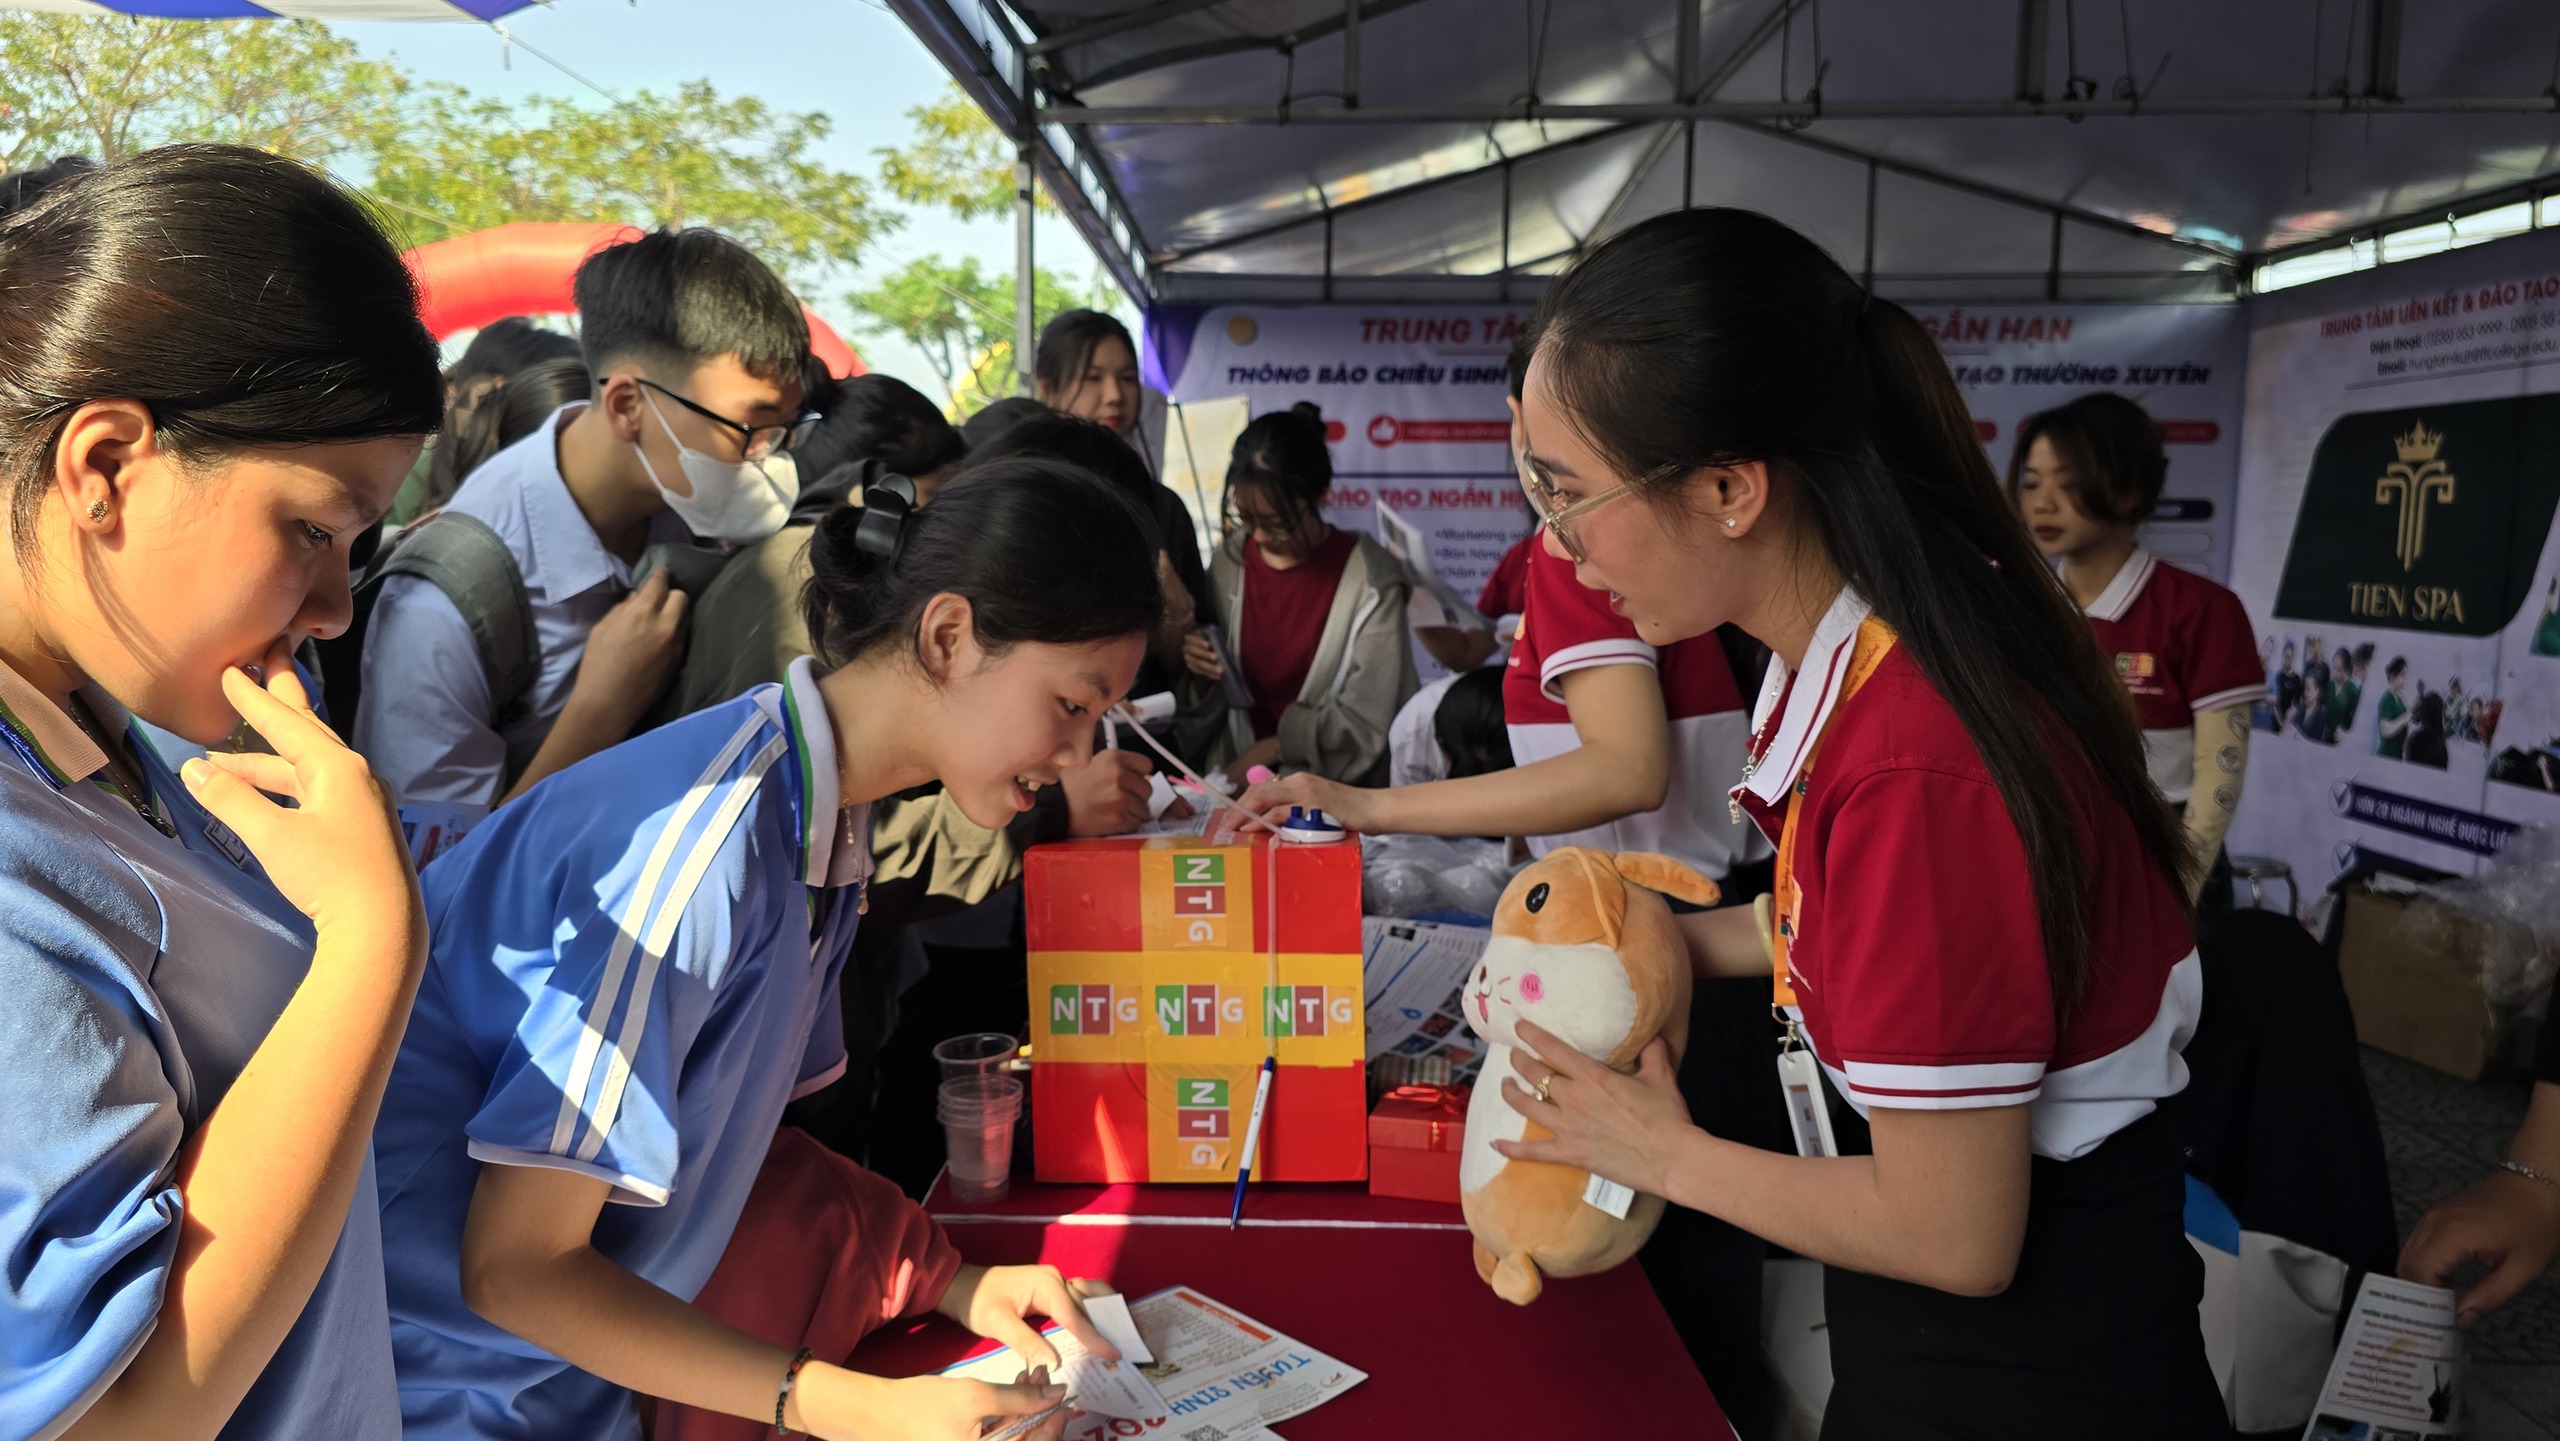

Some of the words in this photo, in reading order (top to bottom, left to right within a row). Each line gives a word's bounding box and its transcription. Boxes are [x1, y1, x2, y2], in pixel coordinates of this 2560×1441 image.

[1361, 317, 1472, 344] TRUNG
[1481, 311, 1518, 344] TÂ
[1921, 308, 1990, 343] GẮN
[1996, 315, 2075, 349] HẠN
[2320, 312, 2362, 338] TRUNG
[2365, 304, 2395, 331] TÂM
[1228, 360, 1311, 385] THÔNG
[1317, 360, 1369, 385] BÁO
[1375, 360, 1445, 385] CHIÊU
[1450, 364, 1509, 385] SINH
[1955, 365, 2004, 391] TẠO
[2010, 361, 2119, 386] THƯỜNG
[2122, 362, 2209, 386] XUYÊN
[1428, 479, 1493, 508] NGẮN
[2347, 581, 2406, 618] TIEN
[2412, 585, 2465, 624] SPA
[1187, 858, 1214, 942] NTG
[1053, 997, 1139, 1023] NTG
[1158, 997, 1244, 1023] NTG
[1269, 997, 1353, 1024] NTG
[1191, 1081, 1217, 1166] NTG
[1171, 1386, 1231, 1416] SINH
